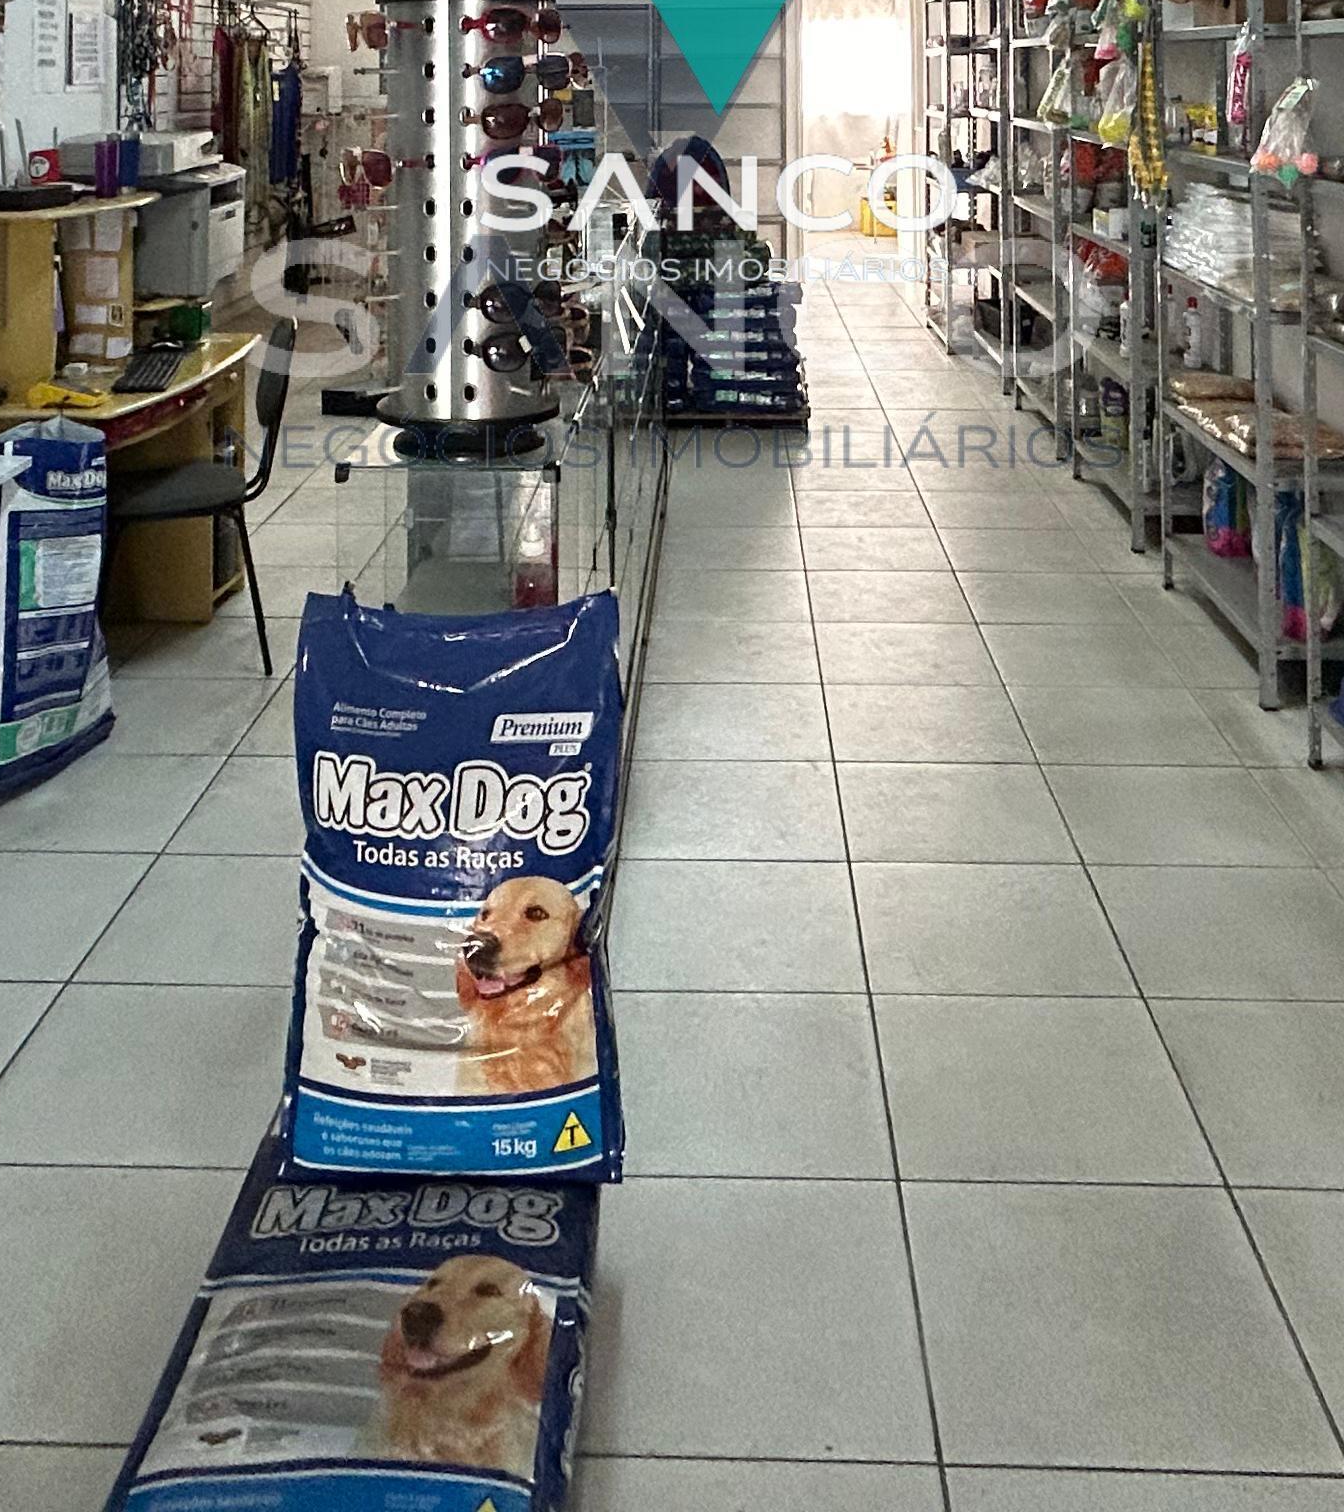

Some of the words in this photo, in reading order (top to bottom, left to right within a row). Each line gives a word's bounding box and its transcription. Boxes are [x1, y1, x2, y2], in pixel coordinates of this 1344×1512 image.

[333, 701, 378, 718] Alimento
[379, 707, 428, 721] Completo
[331, 715, 355, 727] para
[379, 720, 419, 732] Adultos
[499, 717, 584, 738] Premium
[314, 750, 450, 839] Max
[452, 760, 592, 856] Dog
[353, 840, 419, 866] Todas
[424, 851, 450, 867] as
[455, 846, 524, 875] Raças
[251, 1184, 409, 1240] Max
[406, 1183, 564, 1246] Dog
[299, 1231, 370, 1254] Todas
[375, 1234, 403, 1252] as
[408, 1231, 482, 1251] Raças
